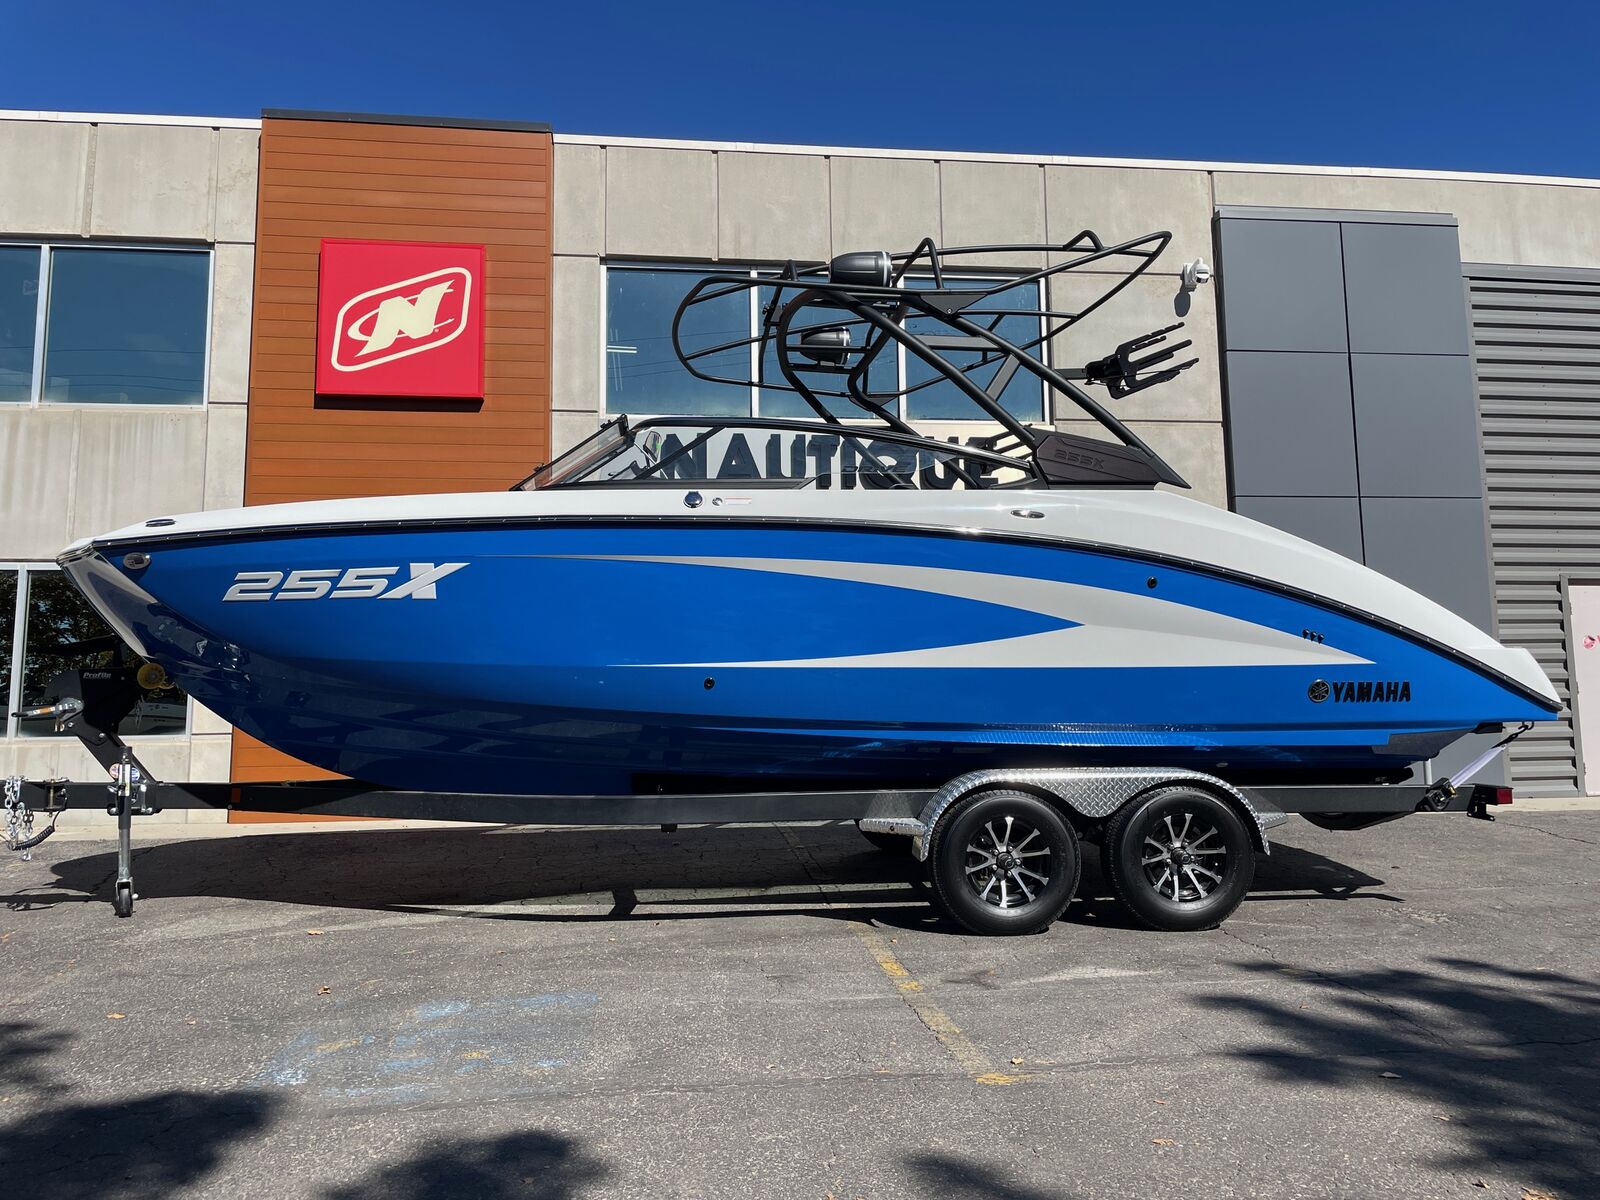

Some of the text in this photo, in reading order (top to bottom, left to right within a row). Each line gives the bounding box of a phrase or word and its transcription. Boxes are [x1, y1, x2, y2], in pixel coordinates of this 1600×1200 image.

[660, 433, 999, 489] NAUTIQUE
[1055, 449, 1105, 470] 255X
[222, 562, 471, 602] 255X
[1332, 681, 1411, 702] YAMAHA
